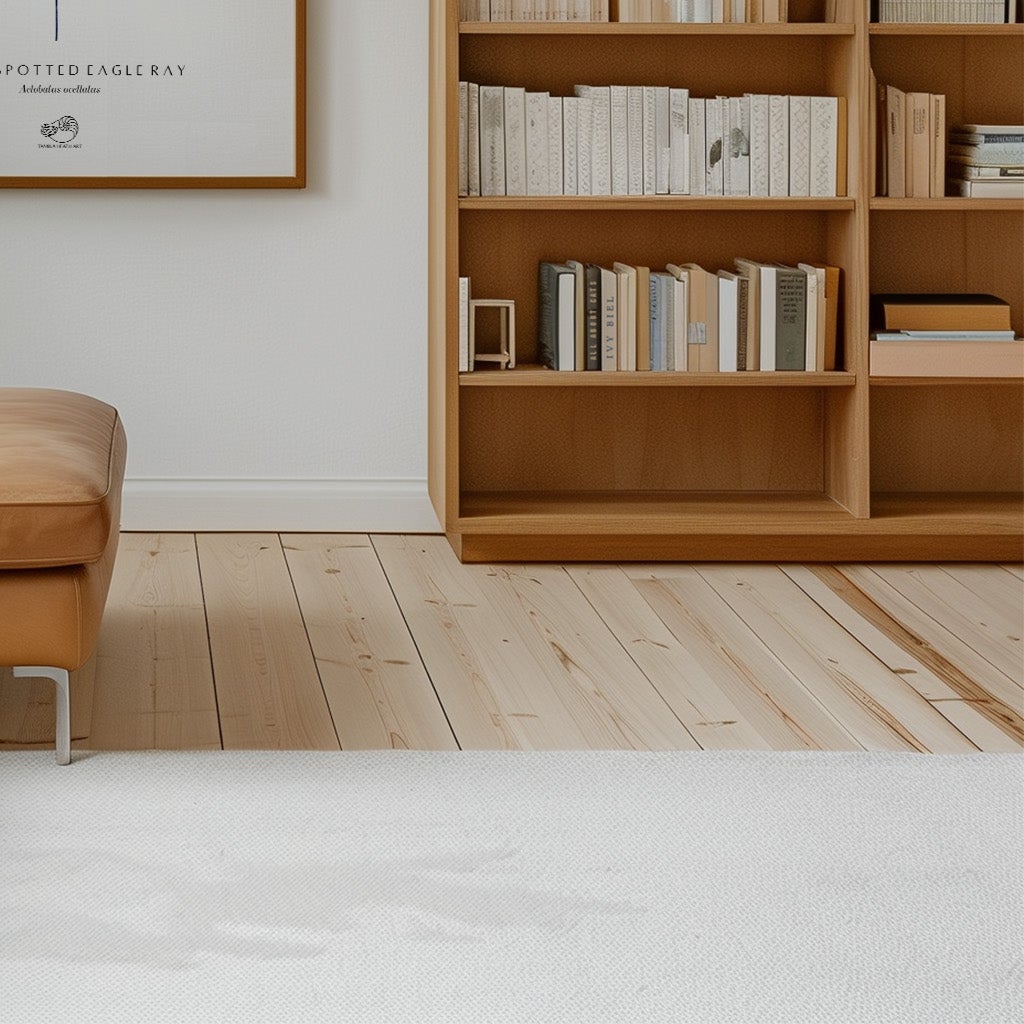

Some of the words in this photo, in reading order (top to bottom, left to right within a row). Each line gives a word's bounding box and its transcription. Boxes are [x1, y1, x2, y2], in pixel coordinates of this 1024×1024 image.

[87, 64, 143, 76] EAGLE
[151, 64, 186, 76] RAY
[589, 281, 598, 304] CATS
[606, 296, 615, 327] BIEL
[589, 310, 598, 339] ABOUT
[589, 344, 598, 361] ALL
[606, 335, 615, 360] IVY
